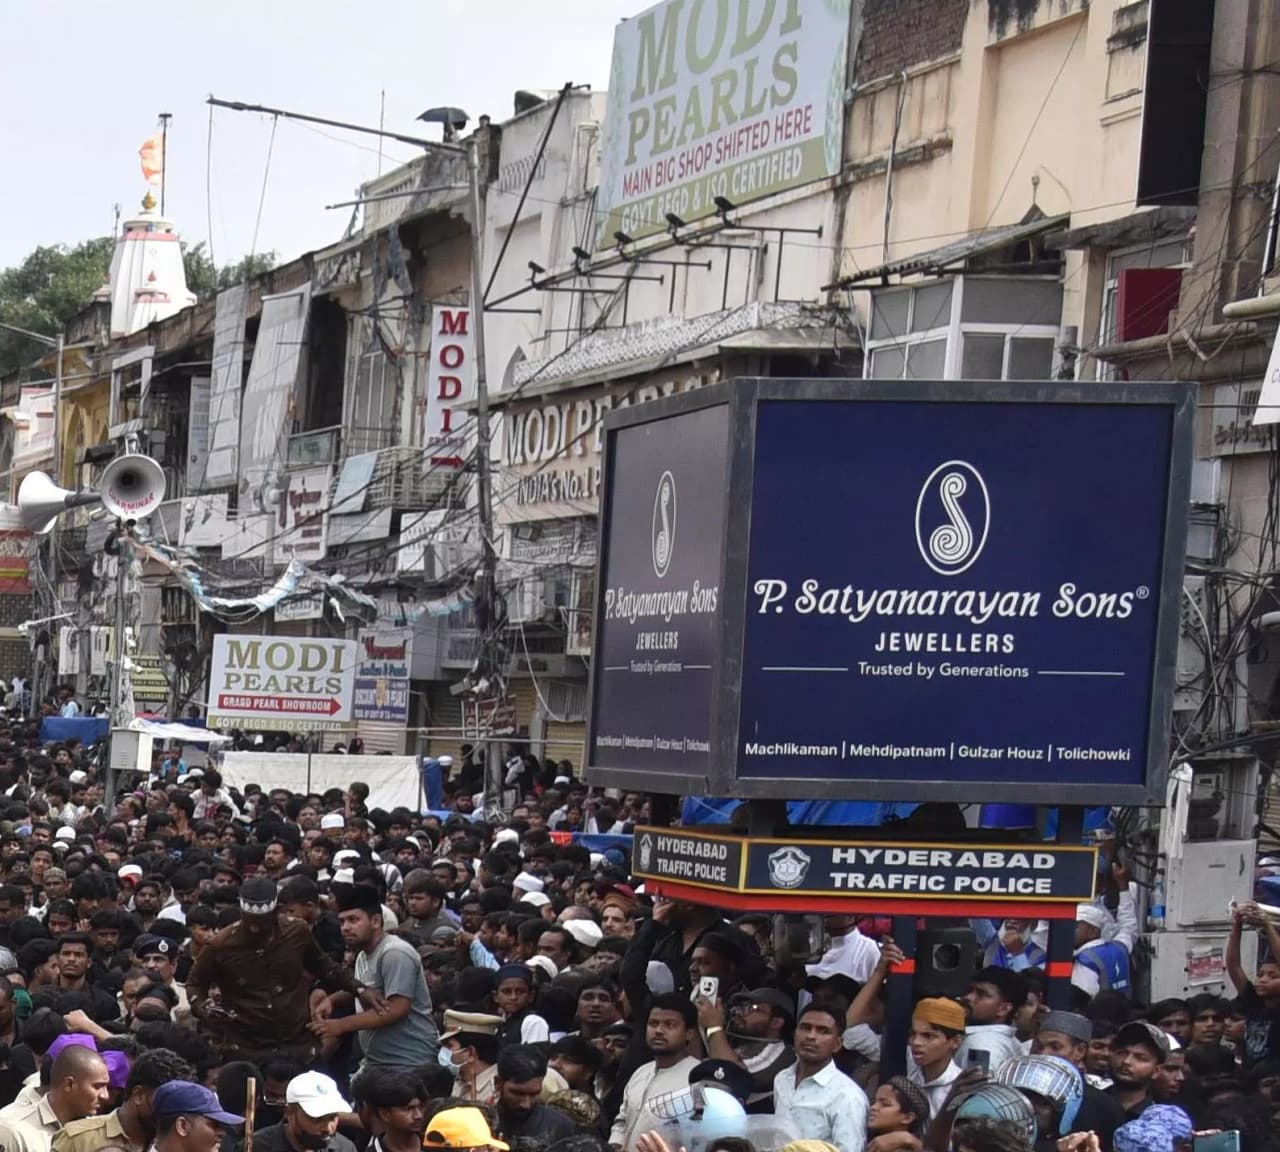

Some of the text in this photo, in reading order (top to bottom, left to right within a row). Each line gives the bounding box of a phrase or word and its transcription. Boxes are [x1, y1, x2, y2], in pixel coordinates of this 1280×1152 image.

[625, 41, 798, 166] PEARLS
[623, 104, 813, 199] MAIN BIG SHOP SHIFTED HERE
[621, 201, 653, 234] GOVT
[732, 148, 802, 195] CERTIFIED
[437, 311, 470, 432] MODI
[505, 402, 570, 467] MODI
[605, 580, 719, 624] P. Satyanarayan Sons
[753, 579, 787, 614] P.
[795, 579, 1040, 625] Satyanarayan
[636, 631, 679, 650] JEWELLERS
[875, 632, 1016, 654] JEWELLERS
[225, 640, 346, 674] MODI
[857, 661, 1030, 680] Trusted by Generations
[223, 672, 342, 695] PEARLS
[223, 697, 331, 712] GRAND PEARL SHOWROOM
[216, 718, 240, 728] GOVT
[745, 741, 1132, 762] Machlikaman Mehdipatnam Gulzar Houz Tolichowki
[657, 837, 729, 861] HYDERABAD
[831, 847, 1056, 869] HYDERABAD
[657, 858, 726, 882] TRAFFIC POLICE
[830, 871, 1052, 894] TRAFFIC POLICE
